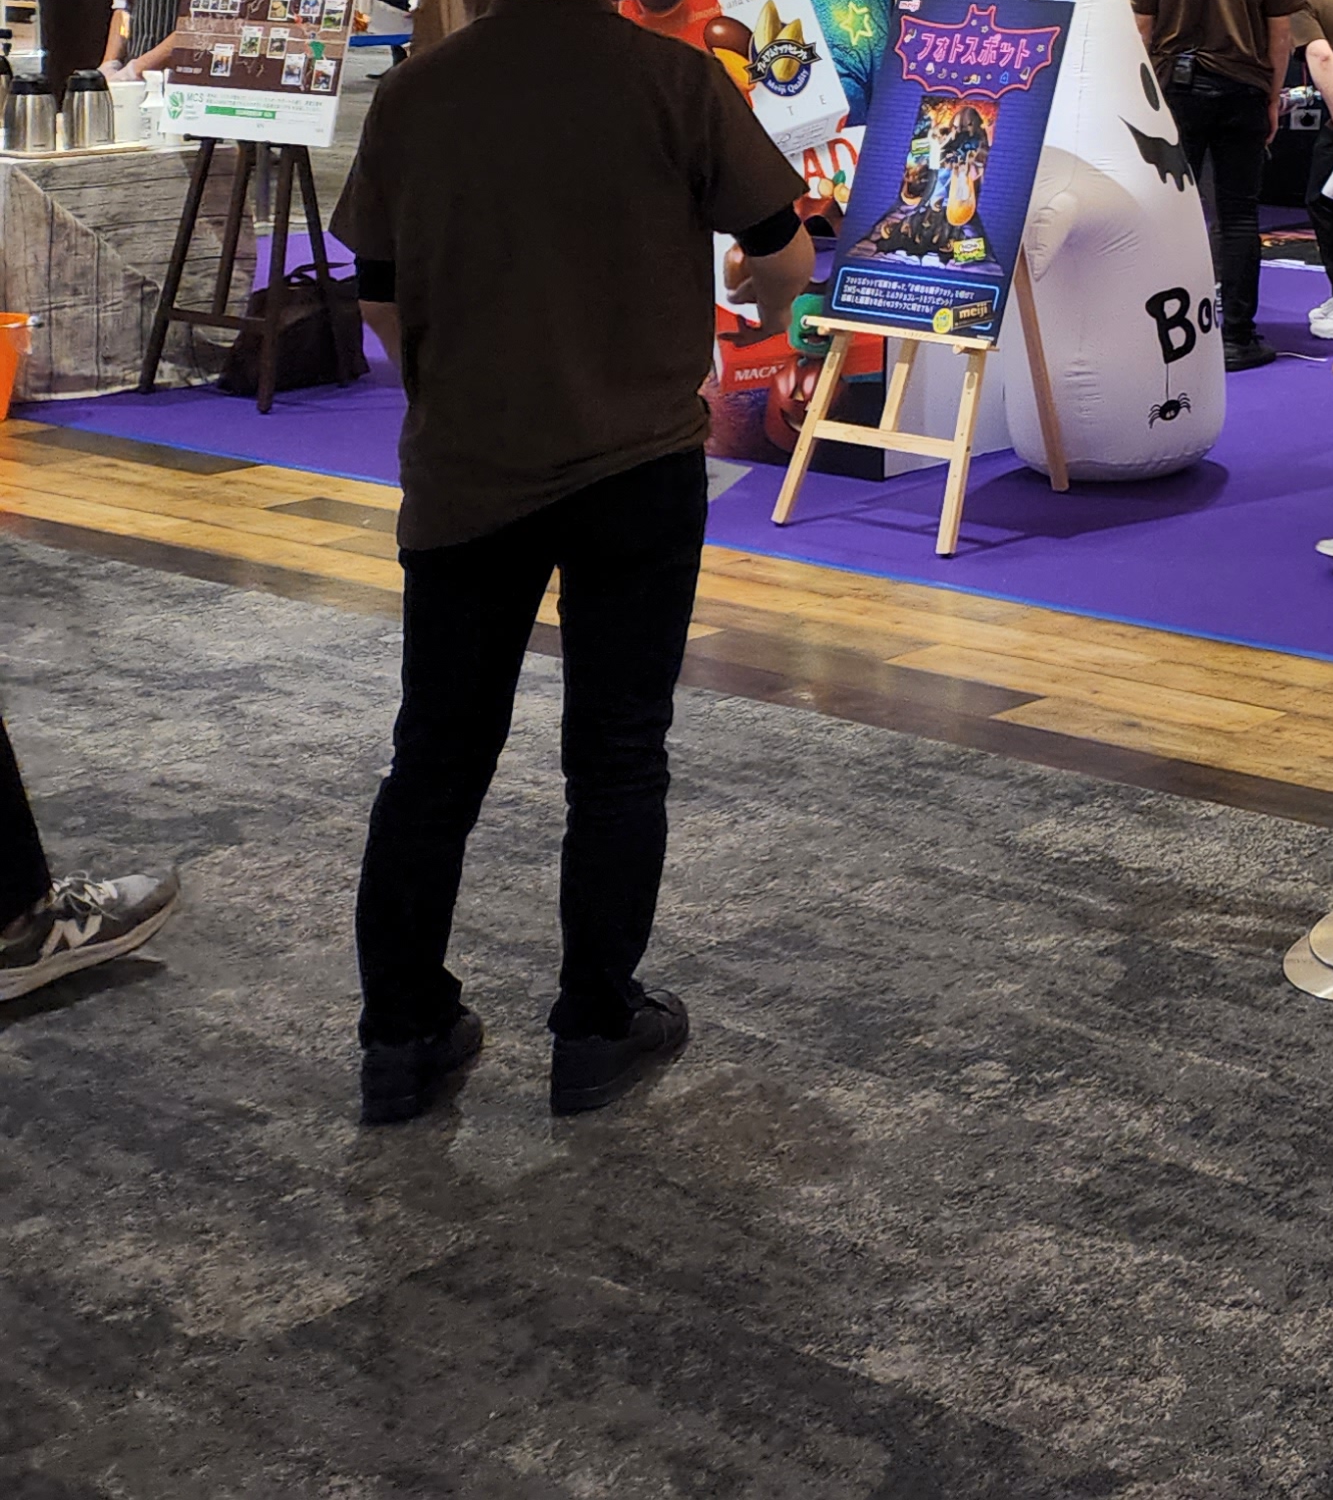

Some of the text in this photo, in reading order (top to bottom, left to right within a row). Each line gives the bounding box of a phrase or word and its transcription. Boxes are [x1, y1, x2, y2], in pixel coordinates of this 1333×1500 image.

[917, 33, 1031, 69] フォトスポット
[959, 303, 988, 319] meiji
